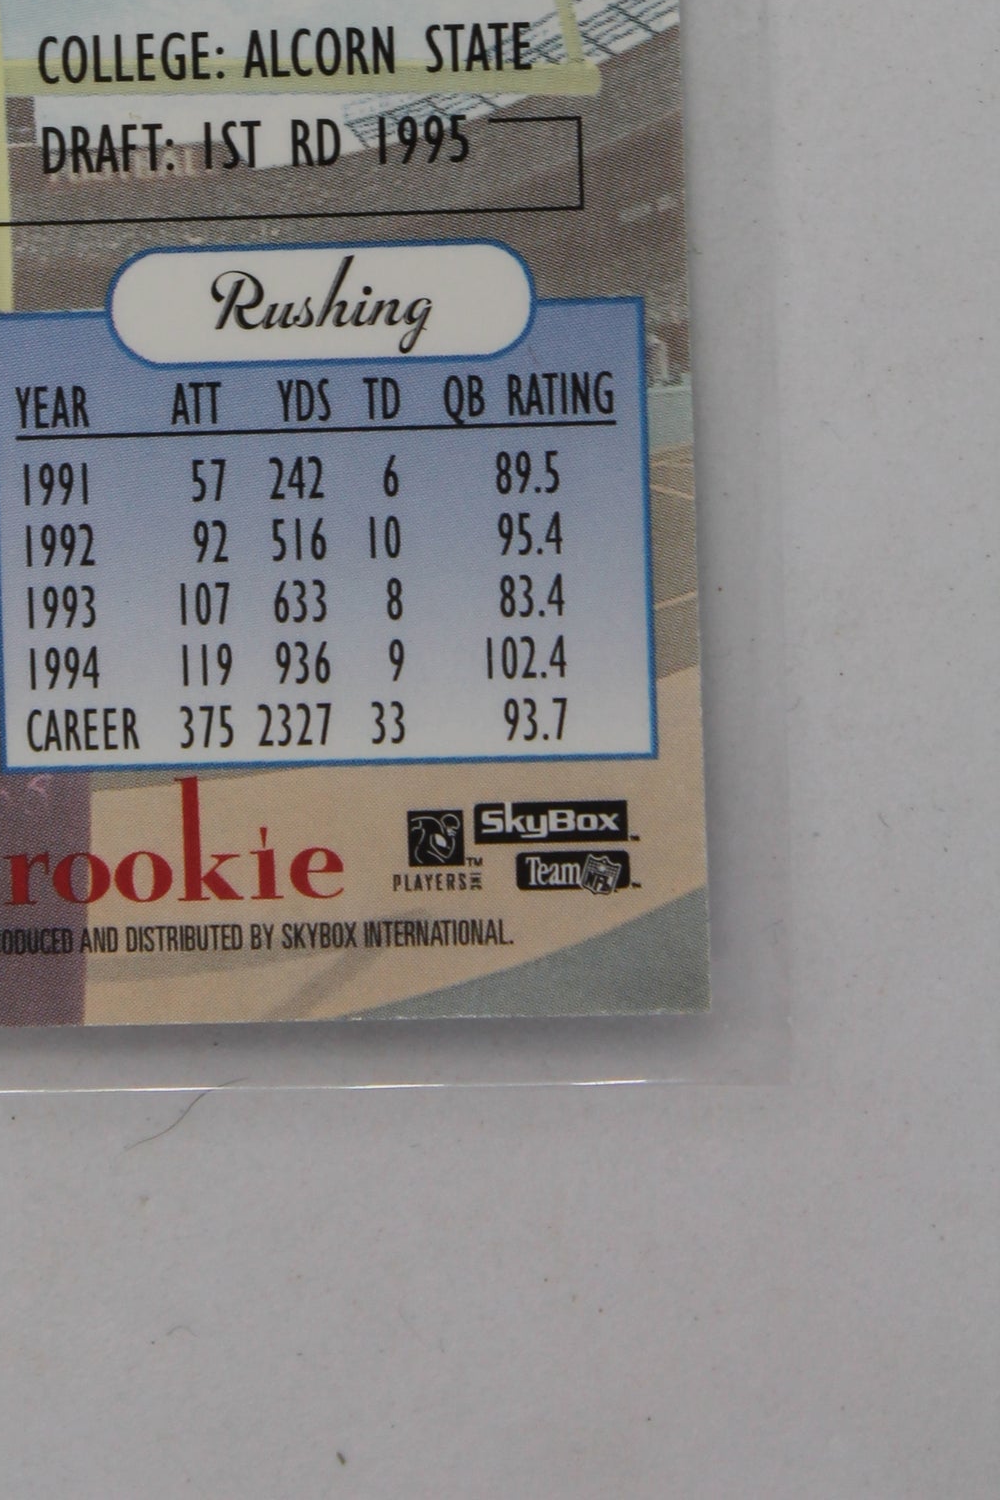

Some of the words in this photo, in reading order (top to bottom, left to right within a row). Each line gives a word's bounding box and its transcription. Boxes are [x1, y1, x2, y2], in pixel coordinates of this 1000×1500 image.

[38, 32, 224, 84] COLLEGE:
[244, 26, 396, 79] ALCORN
[426, 22, 532, 73] STATE
[42, 122, 175, 175] DRAFT:
[291, 119, 342, 166] RD
[379, 115, 469, 164] 1995
[210, 255, 433, 354] Rushing
[16, 385, 89, 428] YEAR
[171, 382, 221, 424] ATT
[277, 378, 331, 422] YDS
[363, 377, 400, 420] TD
[444, 374, 484, 424] QB
[508, 371, 614, 416] RATING
[23, 463, 89, 506] 1991
[192, 459, 225, 501] 57
[269, 457, 324, 500] 242
[383, 455, 398, 497] 6
[497, 450, 560, 494] 89.5
[25, 524, 95, 567] 1992
[193, 520, 228, 563] 92
[271, 517, 326, 561] 516
[369, 516, 400, 559] 10
[498, 512, 562, 556] 95.4
[28, 585, 96, 629] 1993
[180, 582, 229, 625] 107
[274, 580, 327, 623] 633
[387, 577, 402, 621] 8
[500, 573, 564, 617] 83.4
[30, 646, 99, 689] 1994
[182, 643, 232, 686] 119
[276, 641, 330, 683] 936
[388, 639, 404, 681] 9
[486, 635, 566, 680] 102.4
[28, 708, 139, 752] CAREER
[180, 705, 234, 748] 375
[258, 703, 331, 746] 2327
[371, 701, 404, 744] 33
[504, 697, 567, 741] 93.7
[5, 776, 344, 904] rookie
[481, 802, 620, 838] SkyBox
[393, 874, 466, 891] PLAYERS
[526, 856, 580, 886] Team
[82, 926, 118, 953] AND
[126, 924, 242, 950] DISTRIBUTED
[250, 923, 274, 950] BY
[282, 921, 357, 949] SKYBOX
